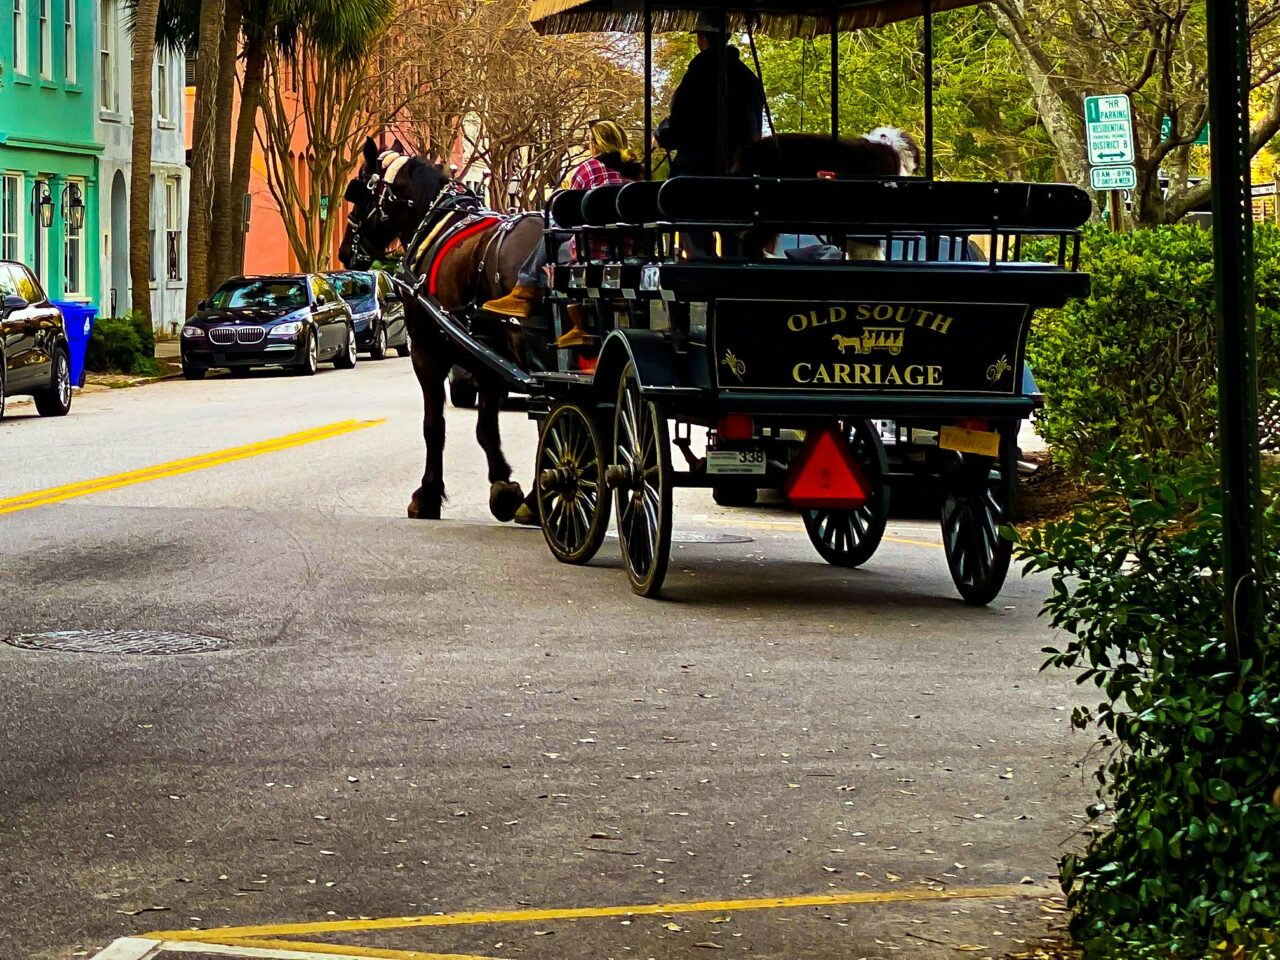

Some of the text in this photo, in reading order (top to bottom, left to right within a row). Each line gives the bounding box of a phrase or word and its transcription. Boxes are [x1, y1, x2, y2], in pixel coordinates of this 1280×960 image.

[1090, 102, 1096, 119] 1
[1100, 110, 1128, 120] PARKING
[1092, 123, 1126, 133] RESIDENTIAL
[1093, 141, 1119, 150] DISTRICT
[1122, 169, 1131, 177] PM
[787, 304, 953, 335] OLD SOUTH
[792, 362, 944, 386] CARRIAGE
[739, 450, 764, 463] 338
